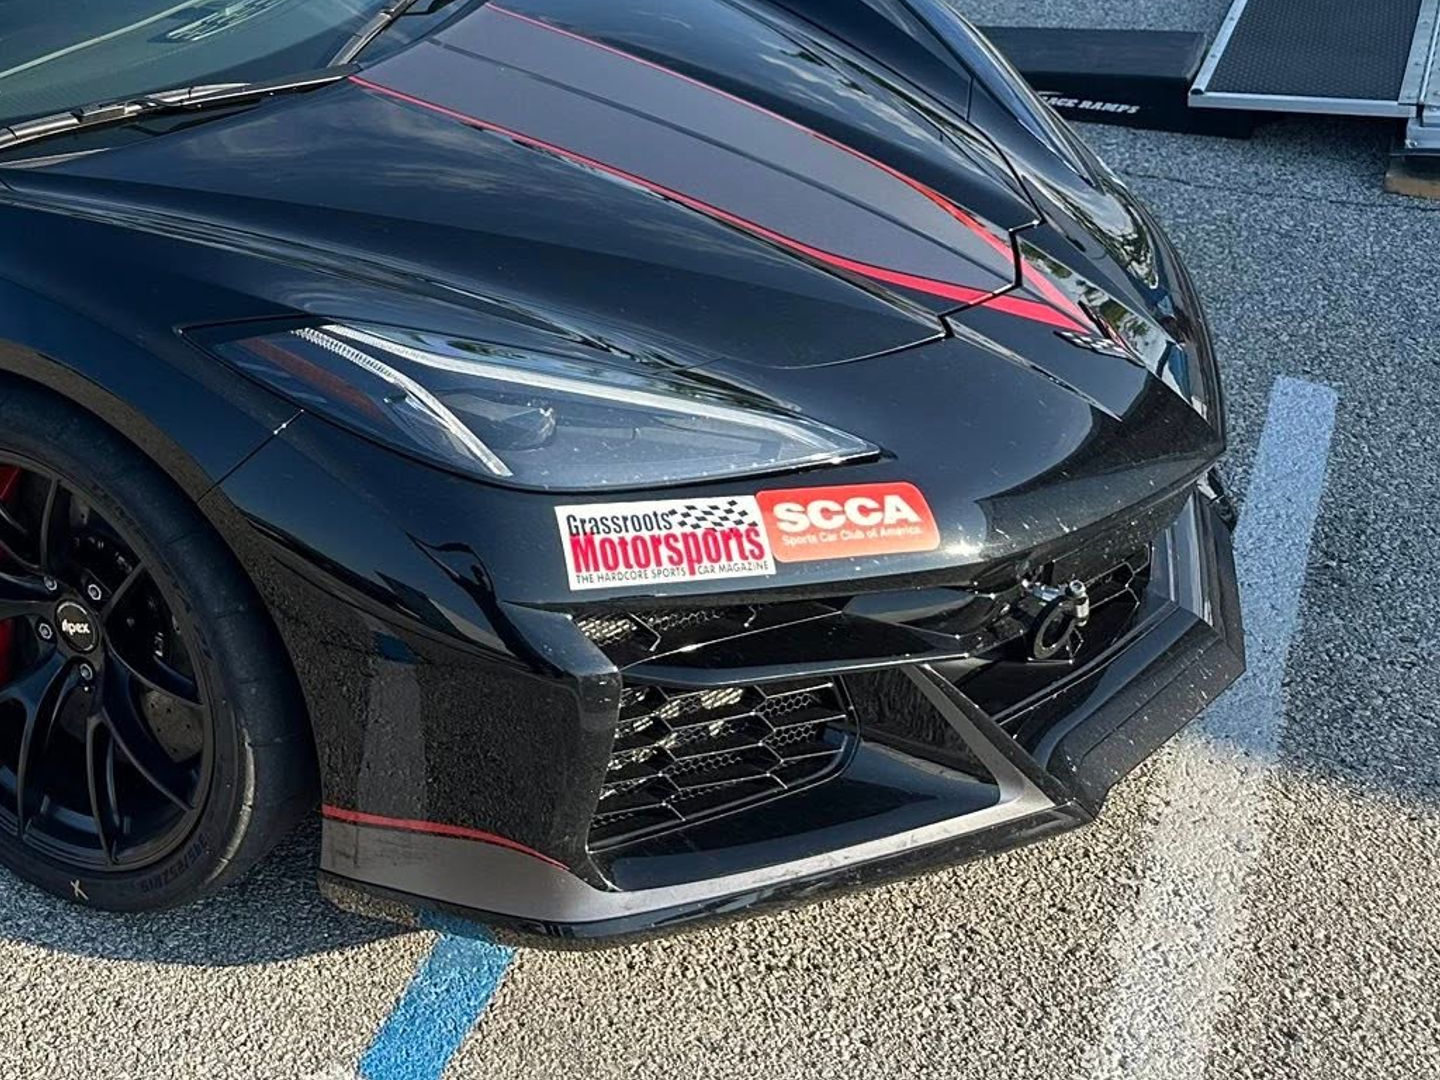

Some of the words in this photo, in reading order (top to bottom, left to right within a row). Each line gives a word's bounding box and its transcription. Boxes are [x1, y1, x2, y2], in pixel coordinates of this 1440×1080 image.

[566, 509, 673, 537] Grassroots
[773, 495, 923, 533] SCCA
[569, 524, 766, 577] Motorsports
[782, 534, 818, 547] Sports
[819, 531, 838, 543] Car
[840, 529, 865, 541] Club
[866, 529, 879, 539] of
[576, 573, 595, 584] THE
[597, 569, 649, 582] HARDCORE
[651, 567, 686, 579] SPORTS
[697, 564, 717, 576] CAR
[718, 561, 769, 574] MAGAZINE
